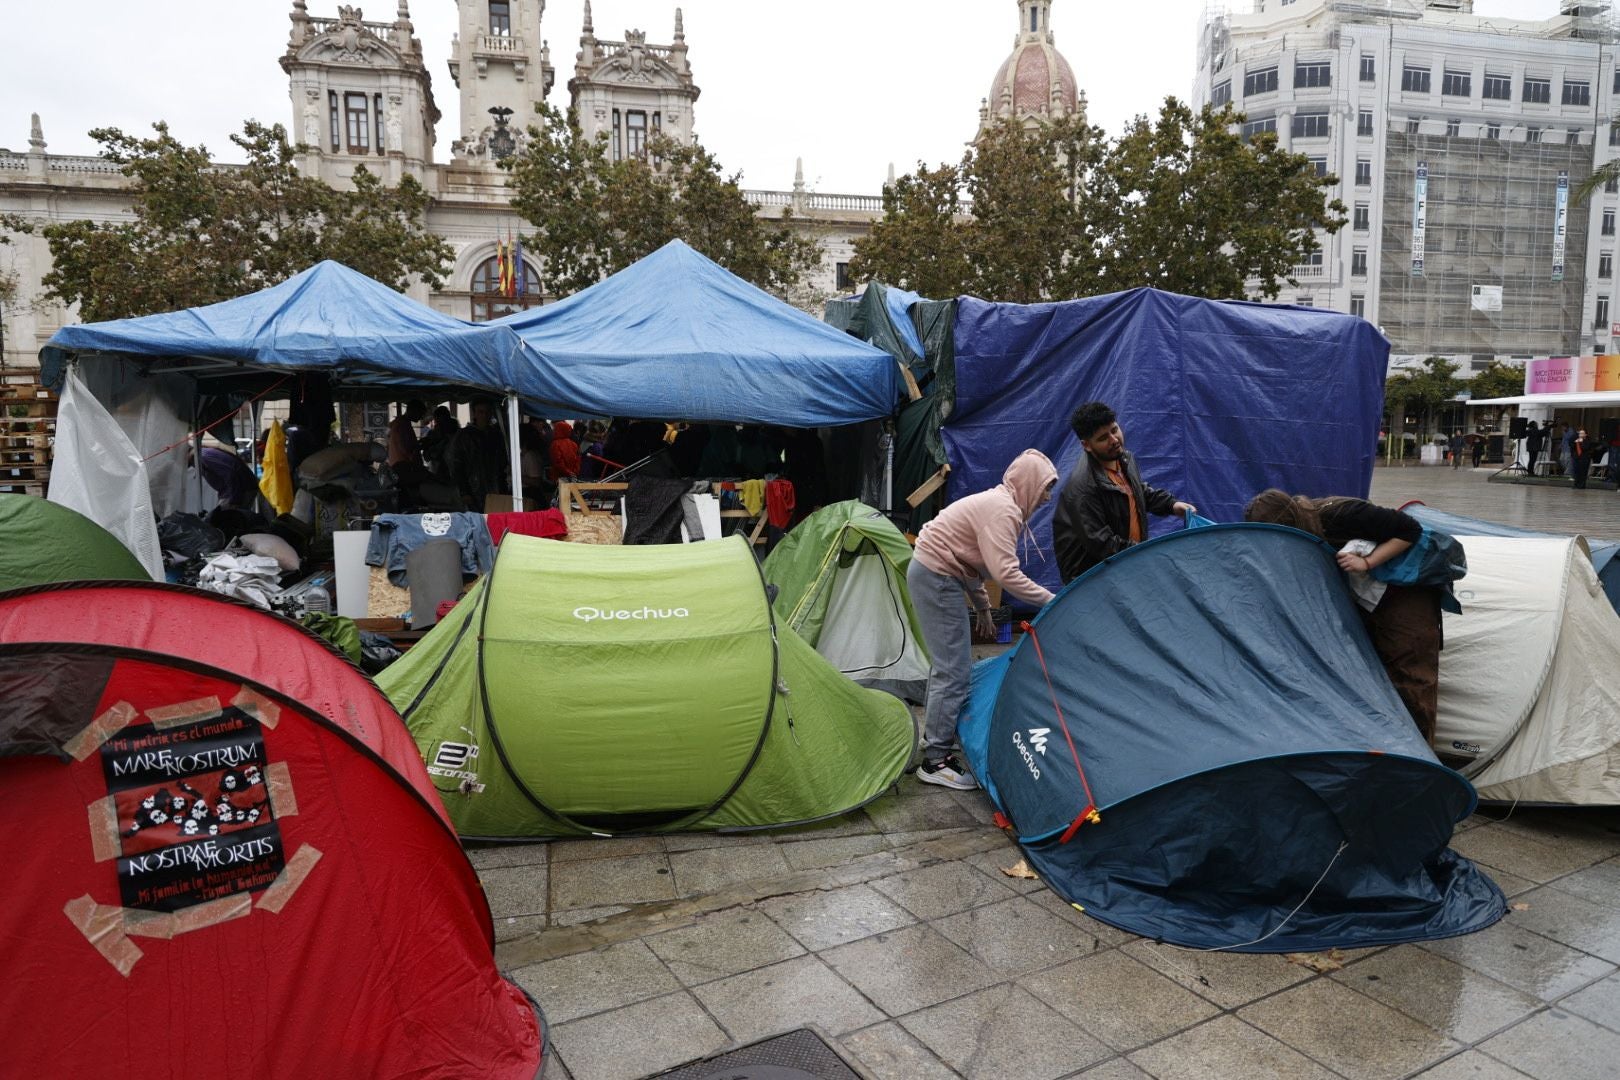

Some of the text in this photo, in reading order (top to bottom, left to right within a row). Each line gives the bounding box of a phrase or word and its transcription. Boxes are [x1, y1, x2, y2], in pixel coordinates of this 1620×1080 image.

[572, 606, 688, 622] Quechua
[172, 732, 187, 742] es
[190, 726, 200, 740] el
[113, 742, 258, 776] MARE NOSTRUM
[1012, 731, 1041, 781] Quechua
[427, 766, 477, 781] seconds
[129, 836, 273, 876] NOSTRAE MORTIS
